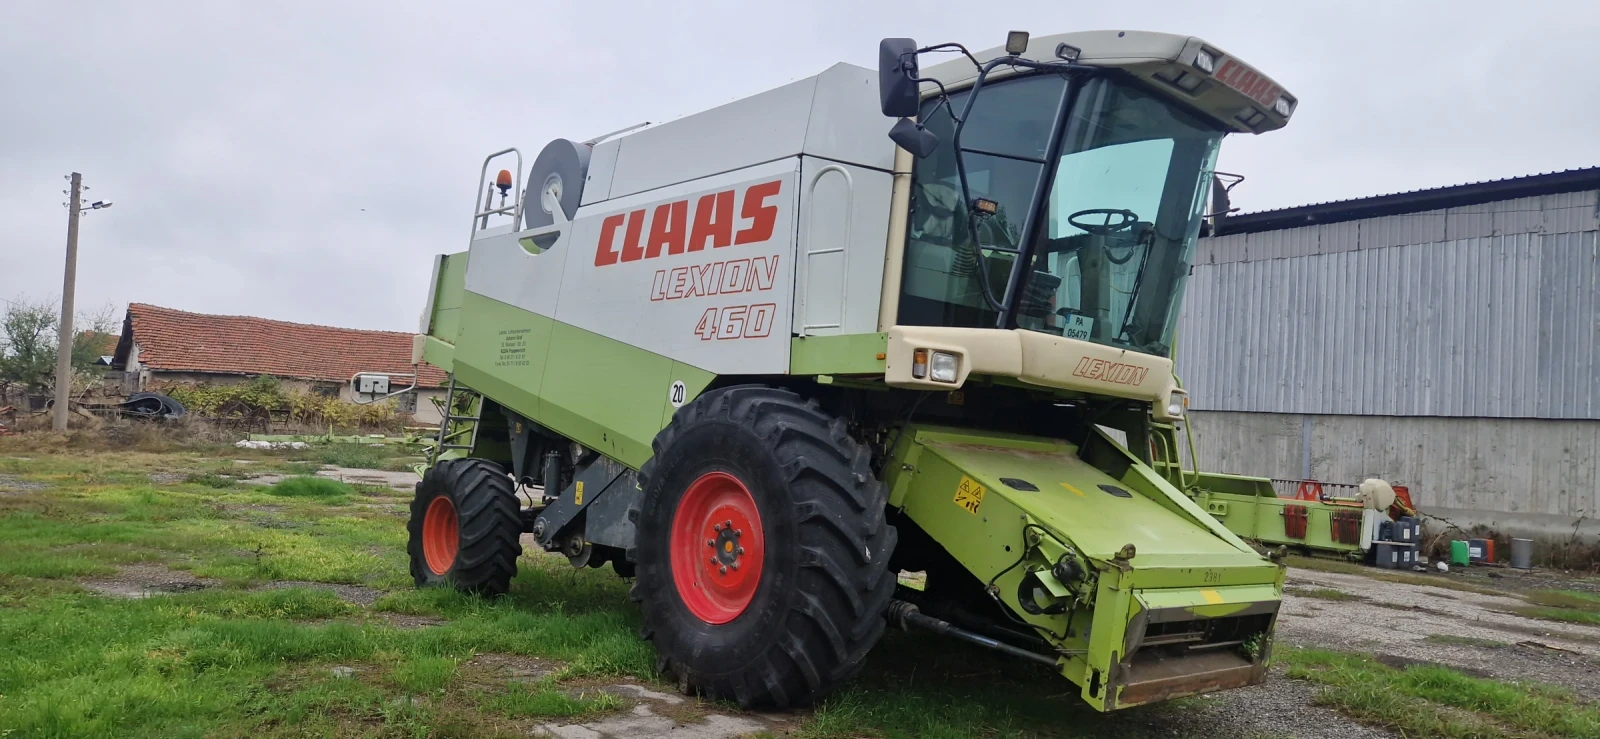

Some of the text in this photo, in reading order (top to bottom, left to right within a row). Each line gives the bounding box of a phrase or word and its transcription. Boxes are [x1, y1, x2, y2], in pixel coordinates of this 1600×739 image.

[1215, 60, 1282, 106] CLAAS
[594, 180, 782, 267] CLAAS
[650, 254, 780, 301] LEXION
[694, 303, 776, 341] 460
[1067, 328, 1088, 339] 05479
[1075, 317, 1083, 326] PA
[1072, 356, 1149, 386] LEXION
[672, 384, 684, 403] 20
